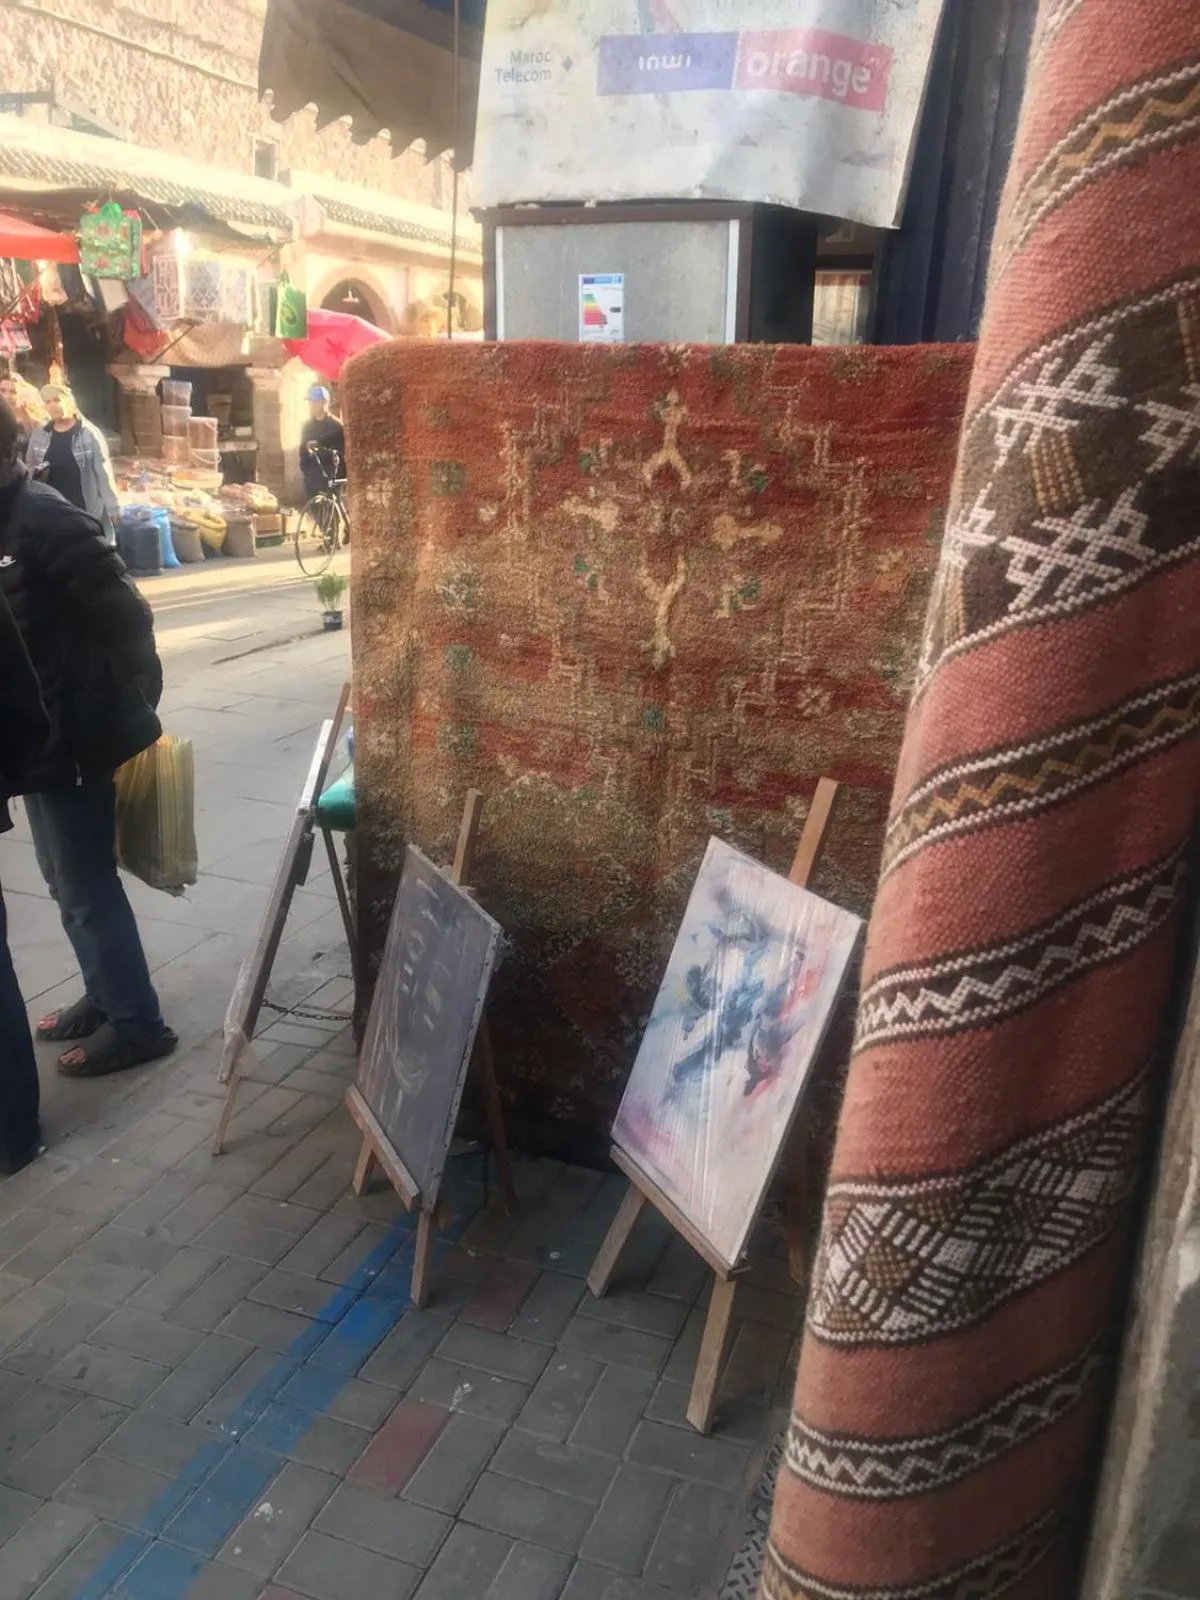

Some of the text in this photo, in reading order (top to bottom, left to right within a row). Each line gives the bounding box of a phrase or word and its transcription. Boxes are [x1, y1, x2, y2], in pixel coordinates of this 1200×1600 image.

[510, 50, 552, 64] Maroc
[495, 68, 552, 83] Telecom
[746, 49, 872, 97] orange
